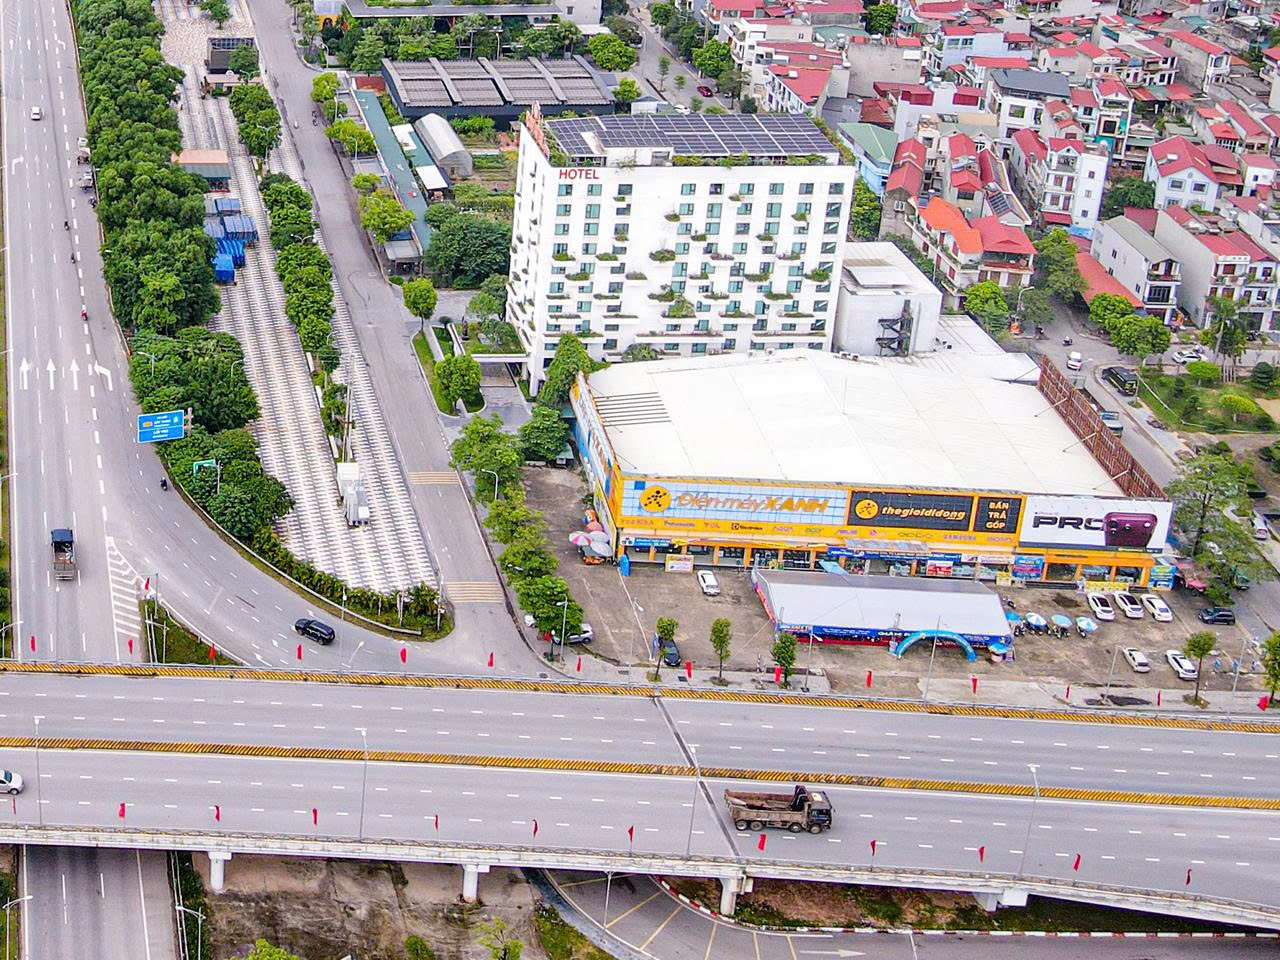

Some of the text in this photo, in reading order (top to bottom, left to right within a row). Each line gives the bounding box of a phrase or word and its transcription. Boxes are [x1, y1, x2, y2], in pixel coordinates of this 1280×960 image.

[559, 169, 600, 179] HOTEL
[762, 495, 829, 513] XANH
[989, 501, 1009, 510] BÁN
[881, 506, 966, 520] thegioididong
[985, 520, 1006, 529] GÓP
